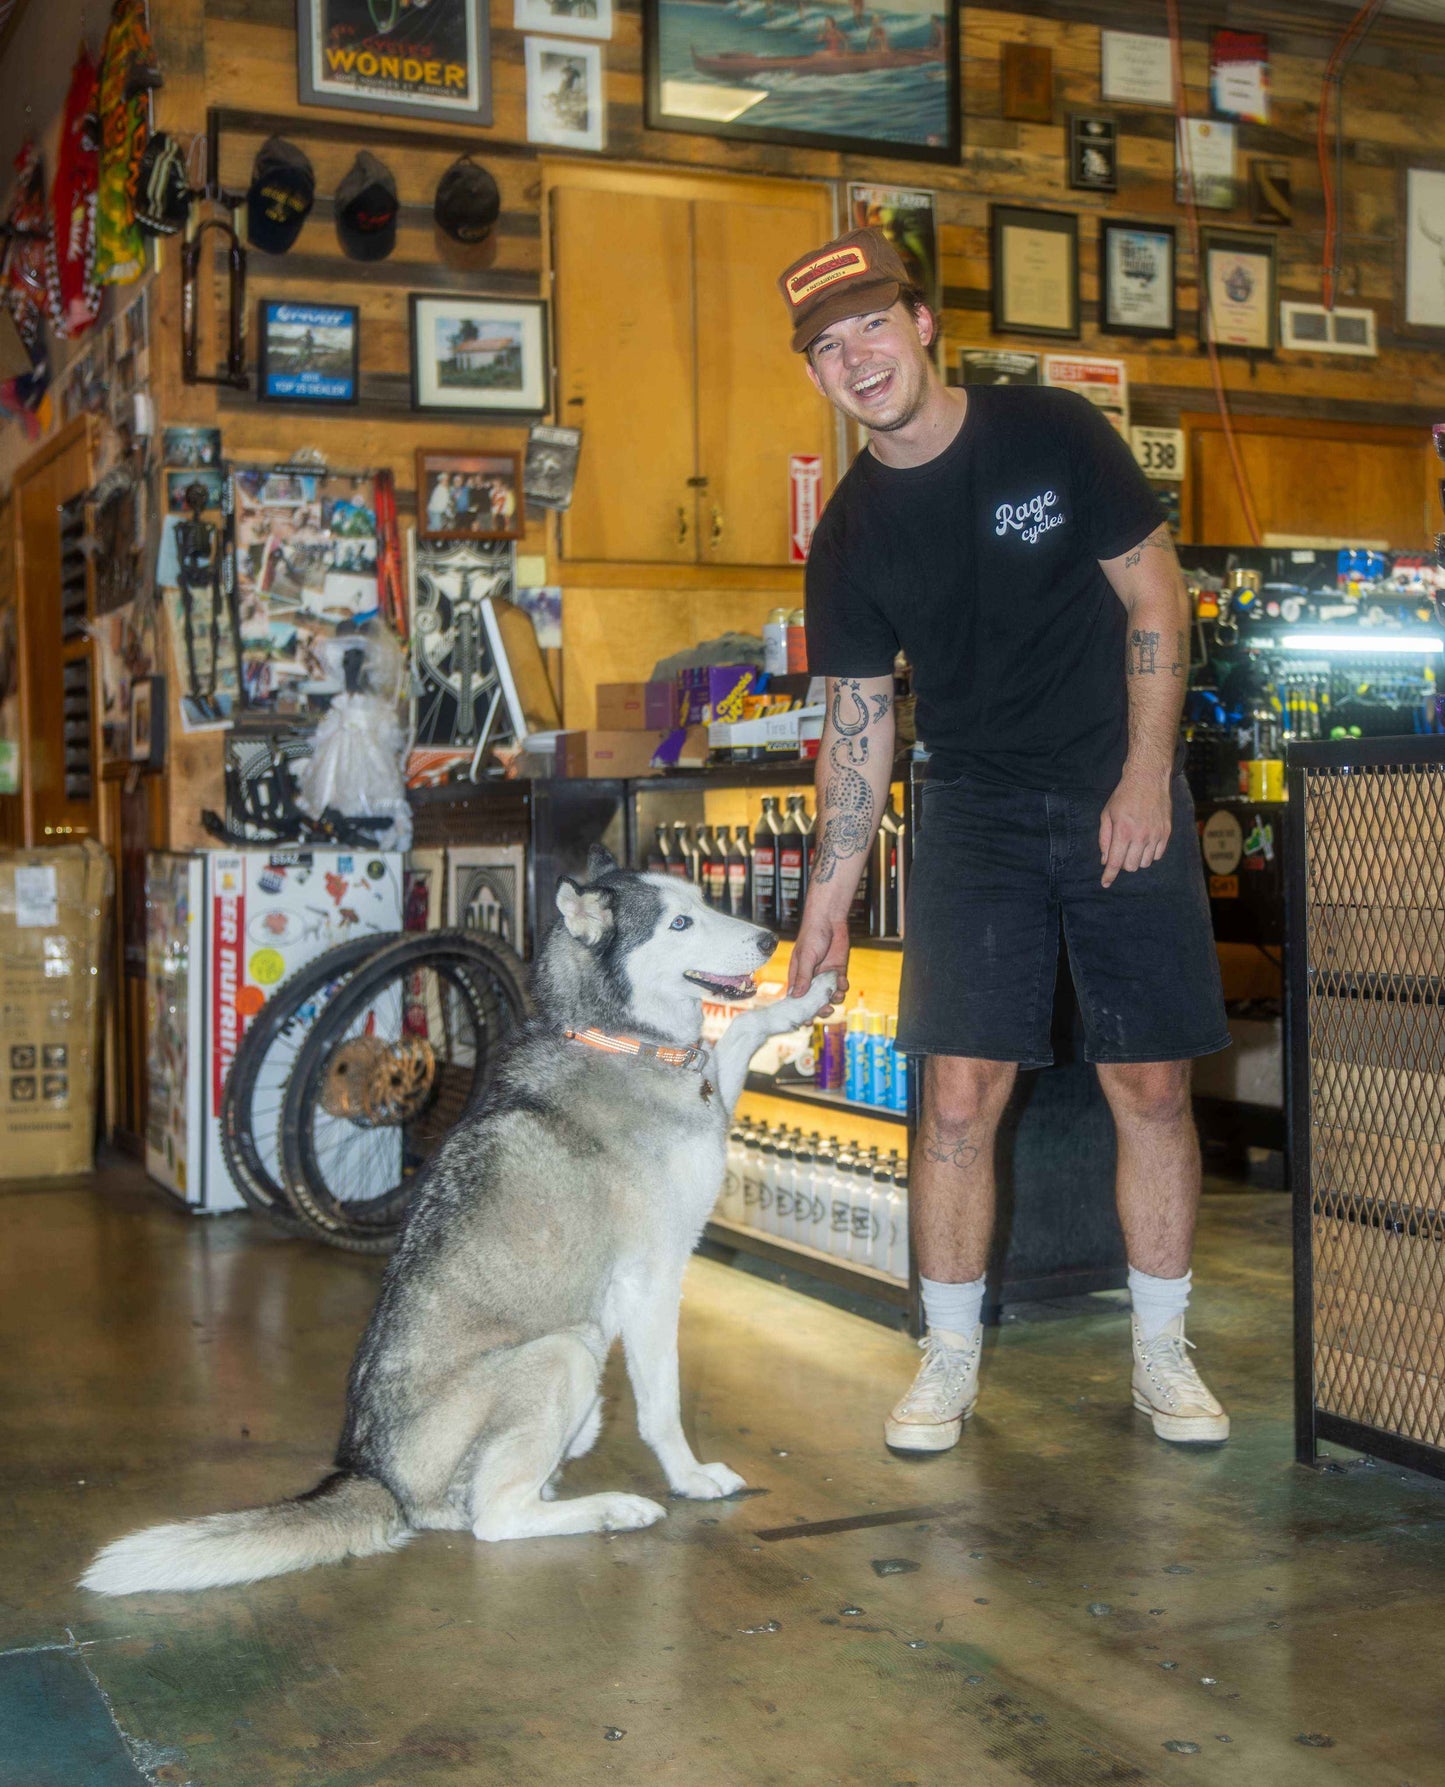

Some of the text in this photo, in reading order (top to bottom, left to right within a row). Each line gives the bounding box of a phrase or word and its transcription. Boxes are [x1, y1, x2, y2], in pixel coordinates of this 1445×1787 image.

[326, 47, 467, 89] WONDER
[275, 381, 295, 392] TOP
[308, 383, 347, 396] DEALER
[1141, 441, 1177, 470] 338
[995, 489, 1057, 536] Rage
[1021, 512, 1064, 544] cycles
[765, 720, 787, 736] Tire
